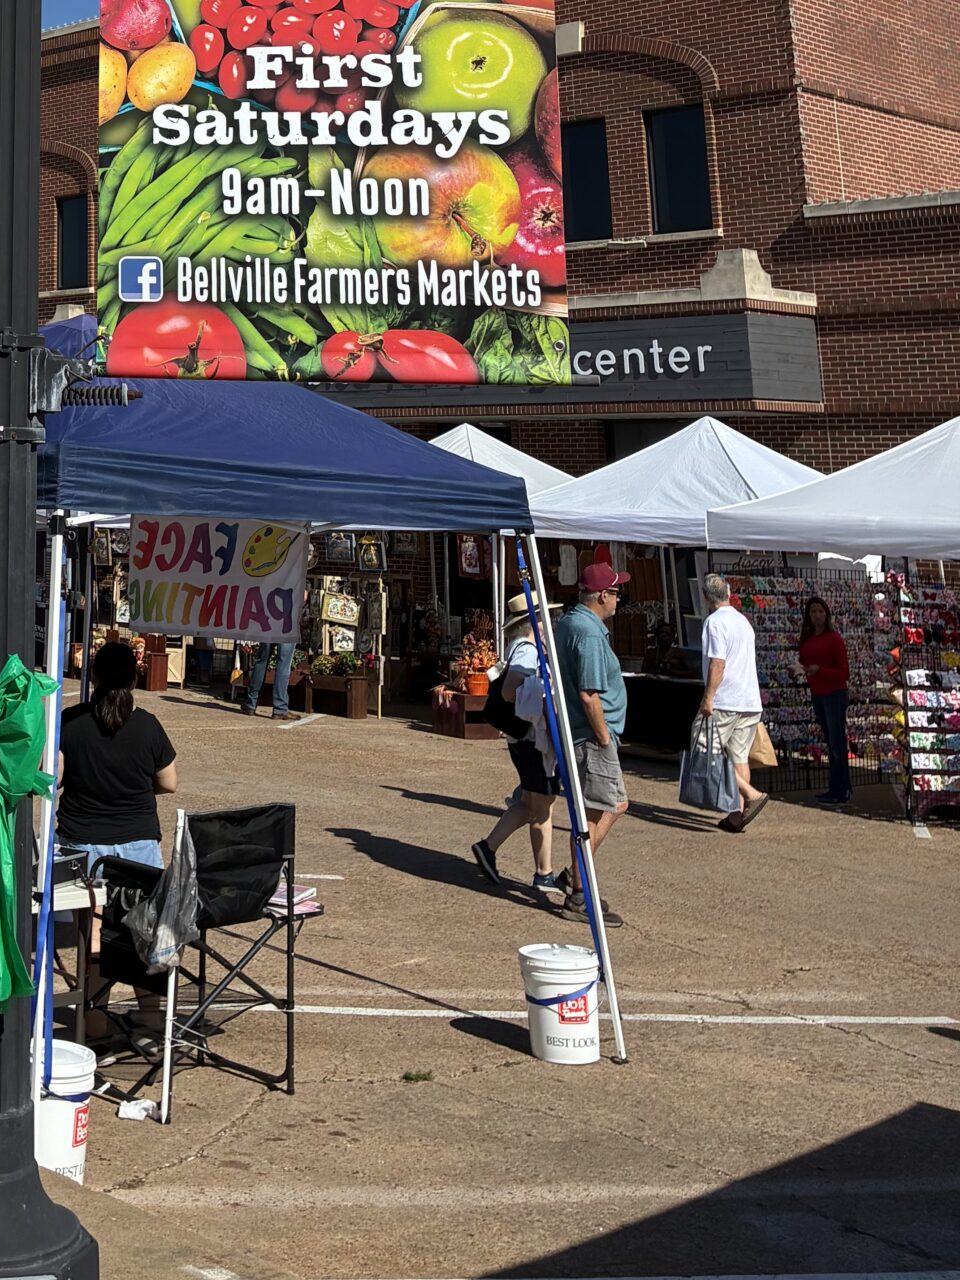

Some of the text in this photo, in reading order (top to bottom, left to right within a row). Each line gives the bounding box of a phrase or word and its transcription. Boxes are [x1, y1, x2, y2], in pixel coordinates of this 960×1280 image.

[245, 44, 423, 91] First
[151, 100, 511, 158] Saturdays
[221, 167, 430, 217] 9am-Noon
[177, 255, 289, 304] Bellville
[294, 262, 411, 306] Farmers
[418, 262, 542, 308] Markets
[573, 339, 713, 376] center
[546, 1035, 597, 1049] BEST LOOK
